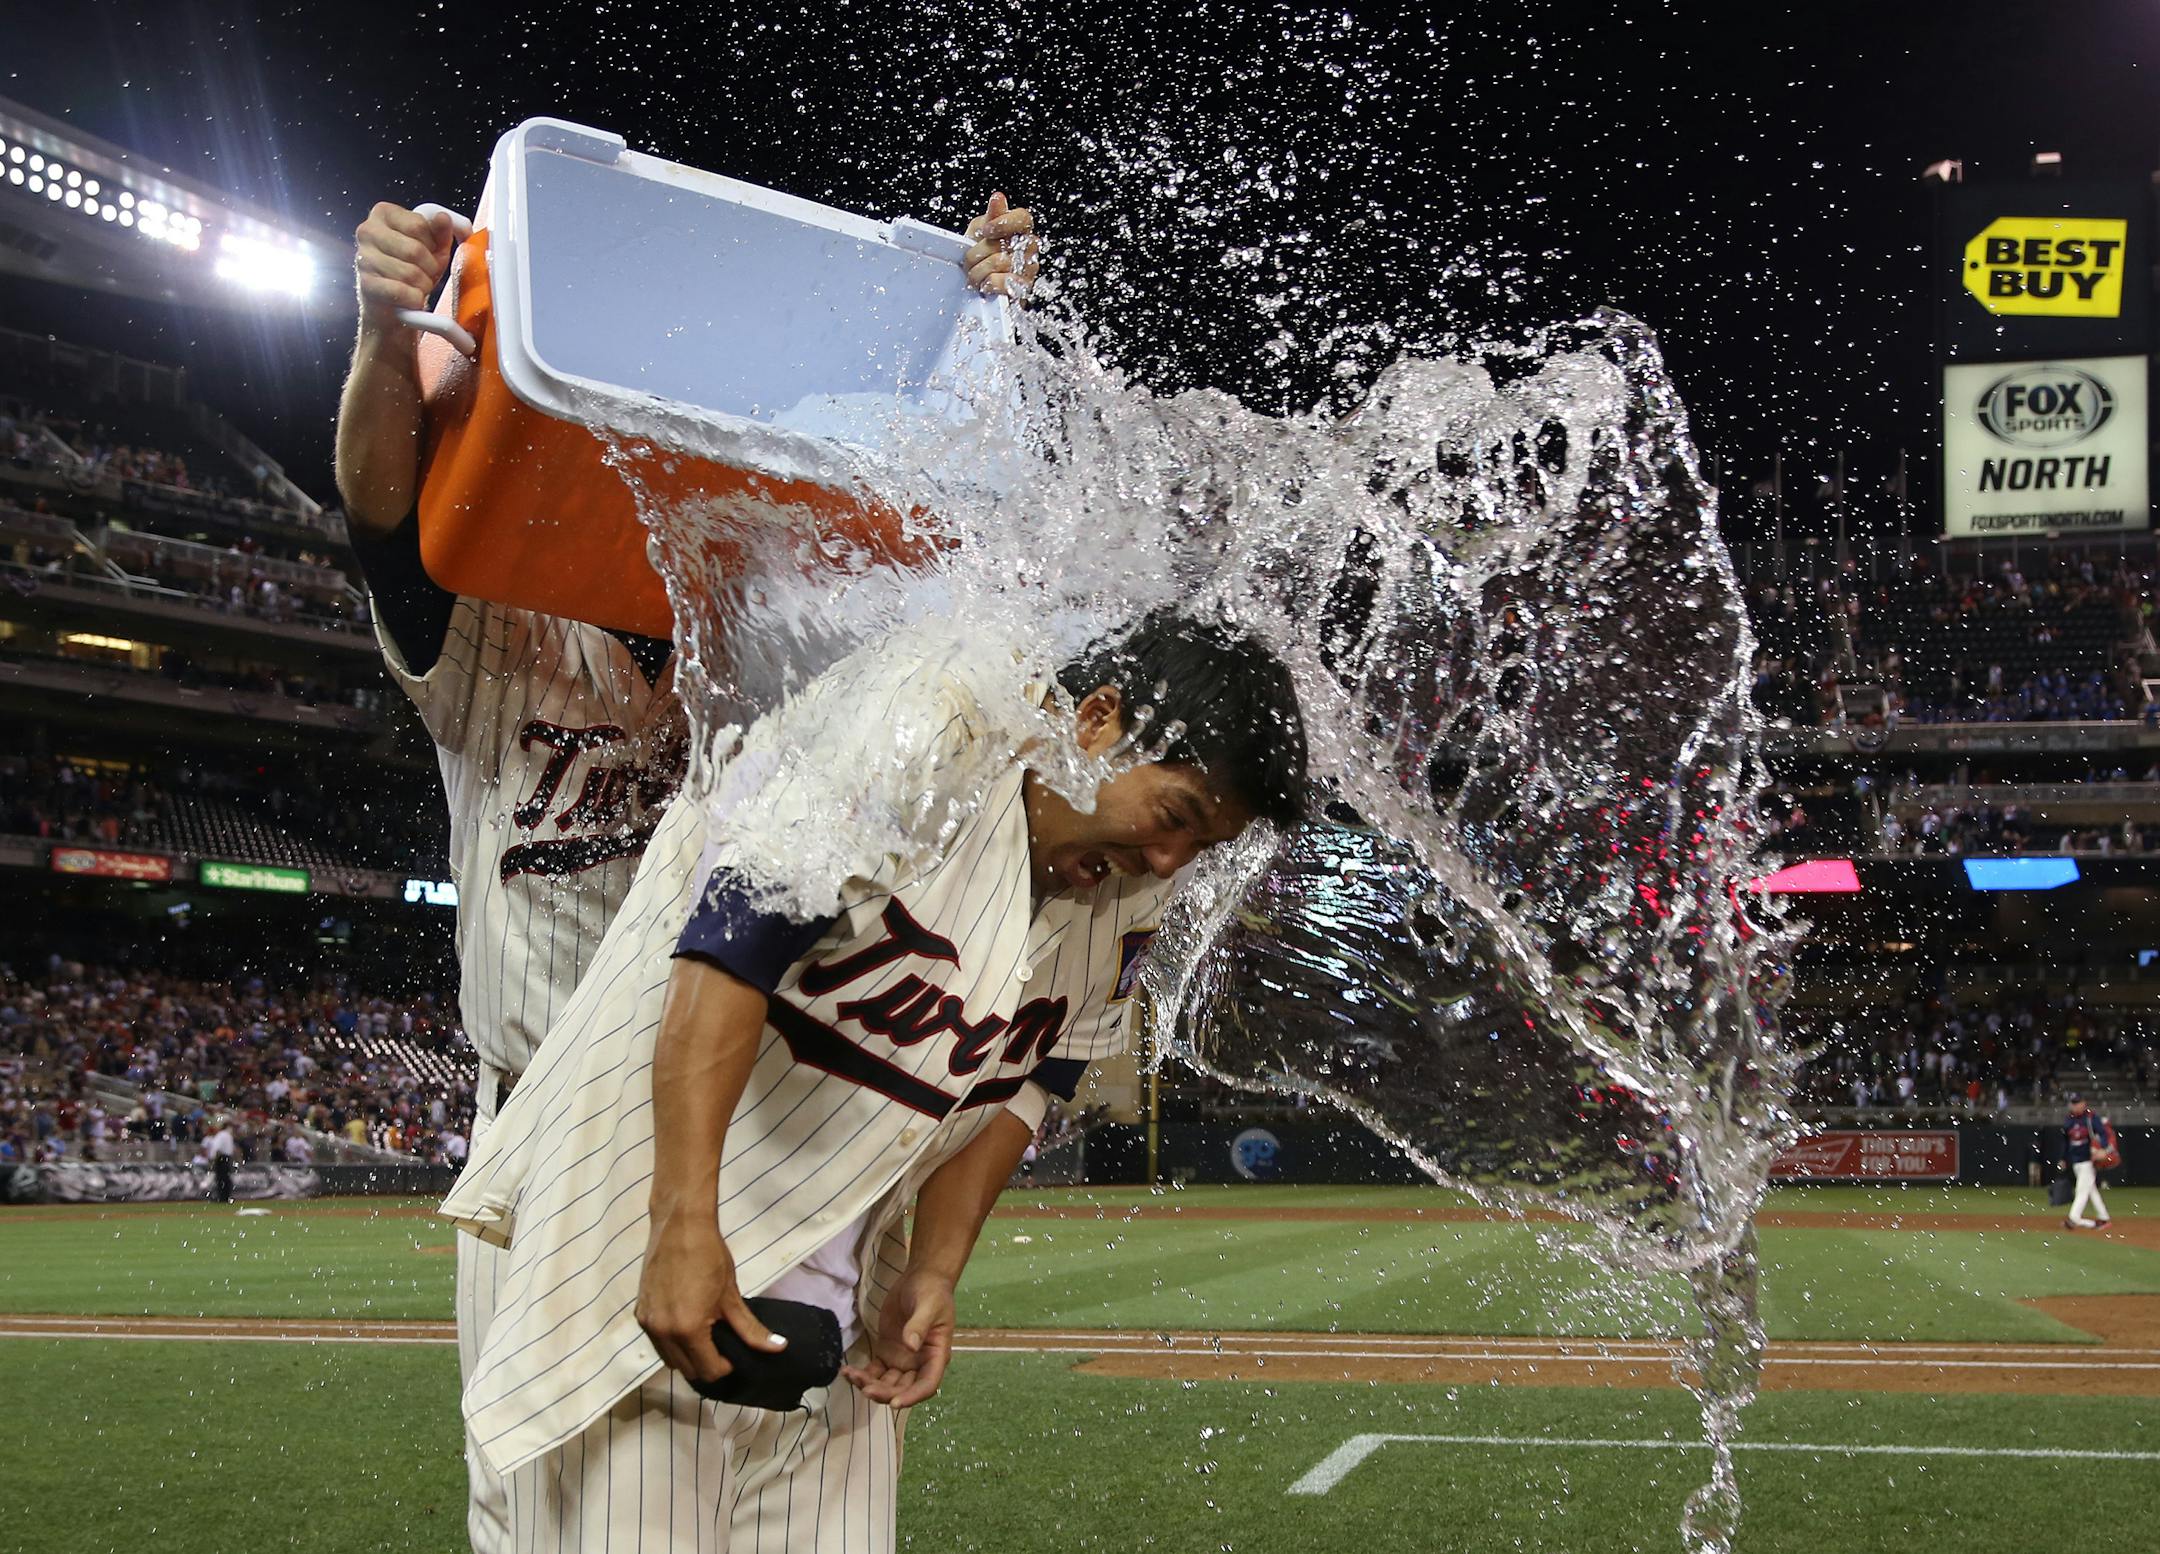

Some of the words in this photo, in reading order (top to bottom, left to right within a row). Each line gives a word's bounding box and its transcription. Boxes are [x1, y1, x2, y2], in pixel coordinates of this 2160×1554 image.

[1985, 238, 2121, 268] BEST
[1989, 270, 2106, 300] BUY
[2006, 383, 2084, 417] FOX
[2005, 418, 2086, 433] SPORTS
[1979, 456, 2111, 491] NORTH
[1970, 510, 2124, 530] FOXSPORTSNORTH.COM
[1861, 1137, 1895, 1154] THIS
[1861, 1155, 1891, 1172] FOR
